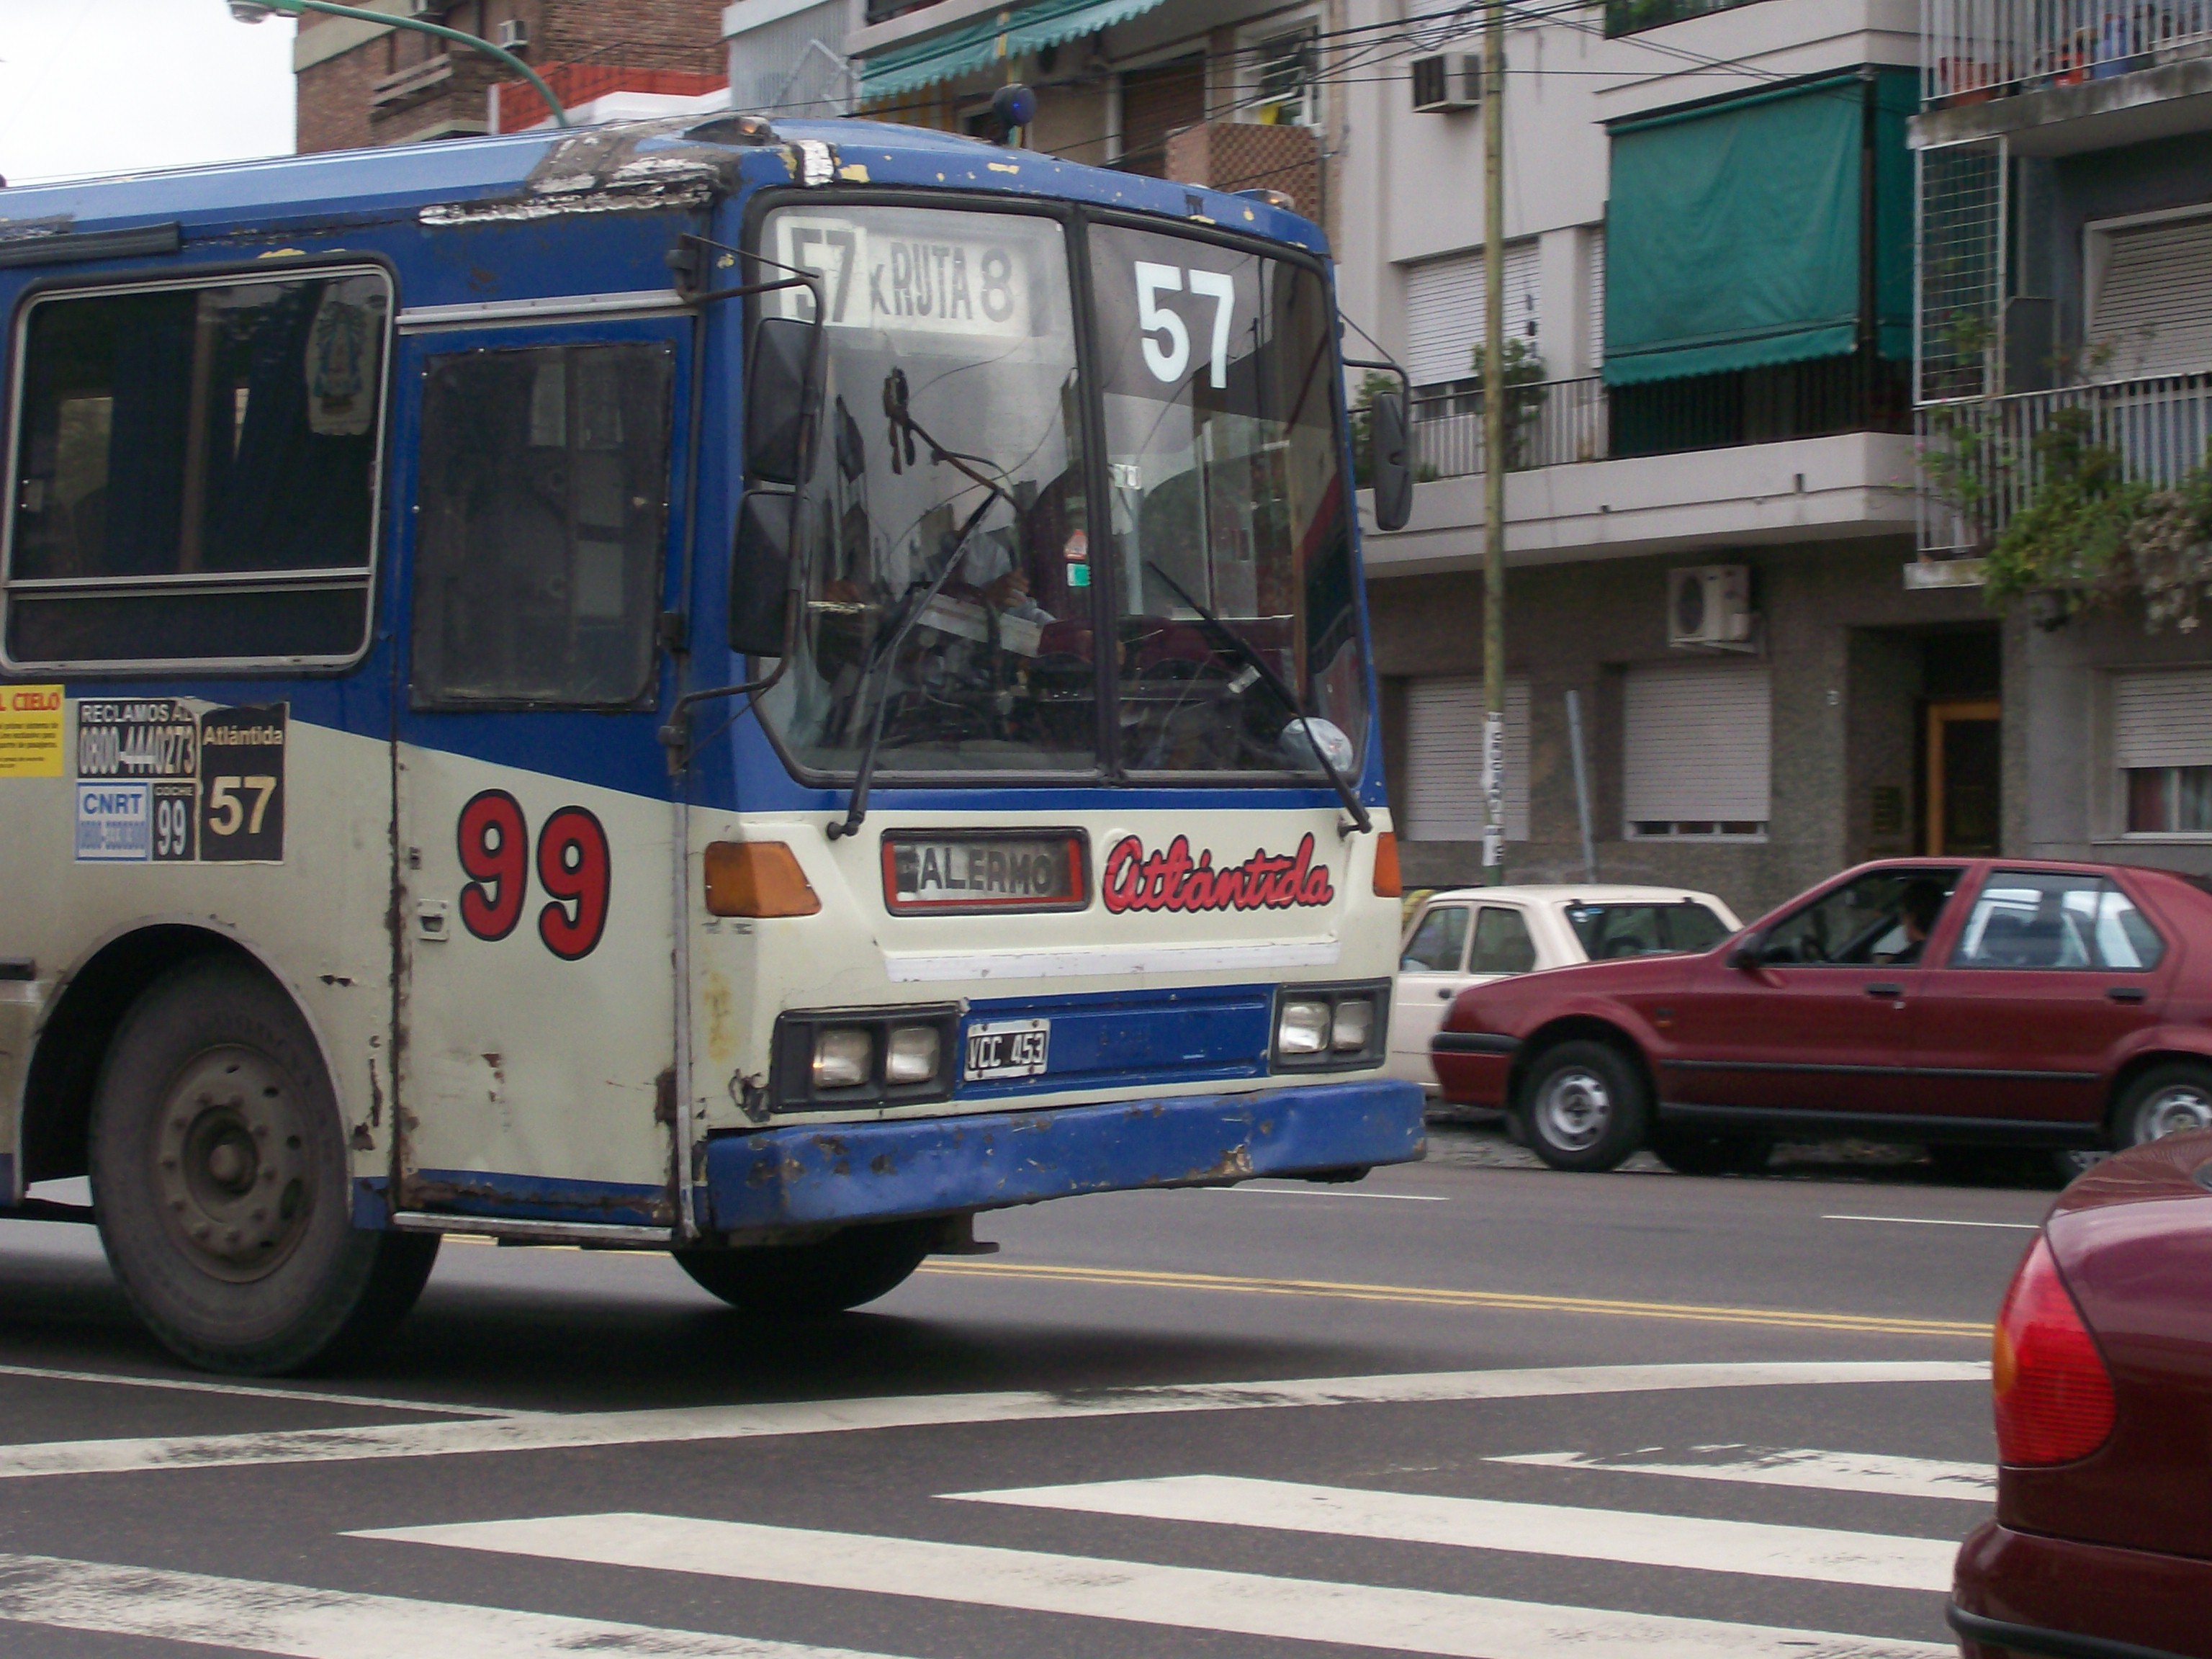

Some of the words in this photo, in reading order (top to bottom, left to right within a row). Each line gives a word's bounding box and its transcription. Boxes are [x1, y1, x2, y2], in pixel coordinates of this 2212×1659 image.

[791, 226, 855, 323] 57
[891, 242, 972, 319] RUTA
[981, 248, 1013, 323] 8
[1134, 261, 1236, 389] 57
[13, 692, 60, 711] CIELO
[81, 703, 170, 723] RECLAMOS
[202, 724, 284, 746] Atlántida
[83, 793, 143, 815] CNRT
[158, 799, 186, 855] 99
[209, 775, 276, 836] 57
[457, 788, 611, 961] 99
[969, 1035, 1003, 1069] VCC
[1011, 1032, 1045, 1065] 453
